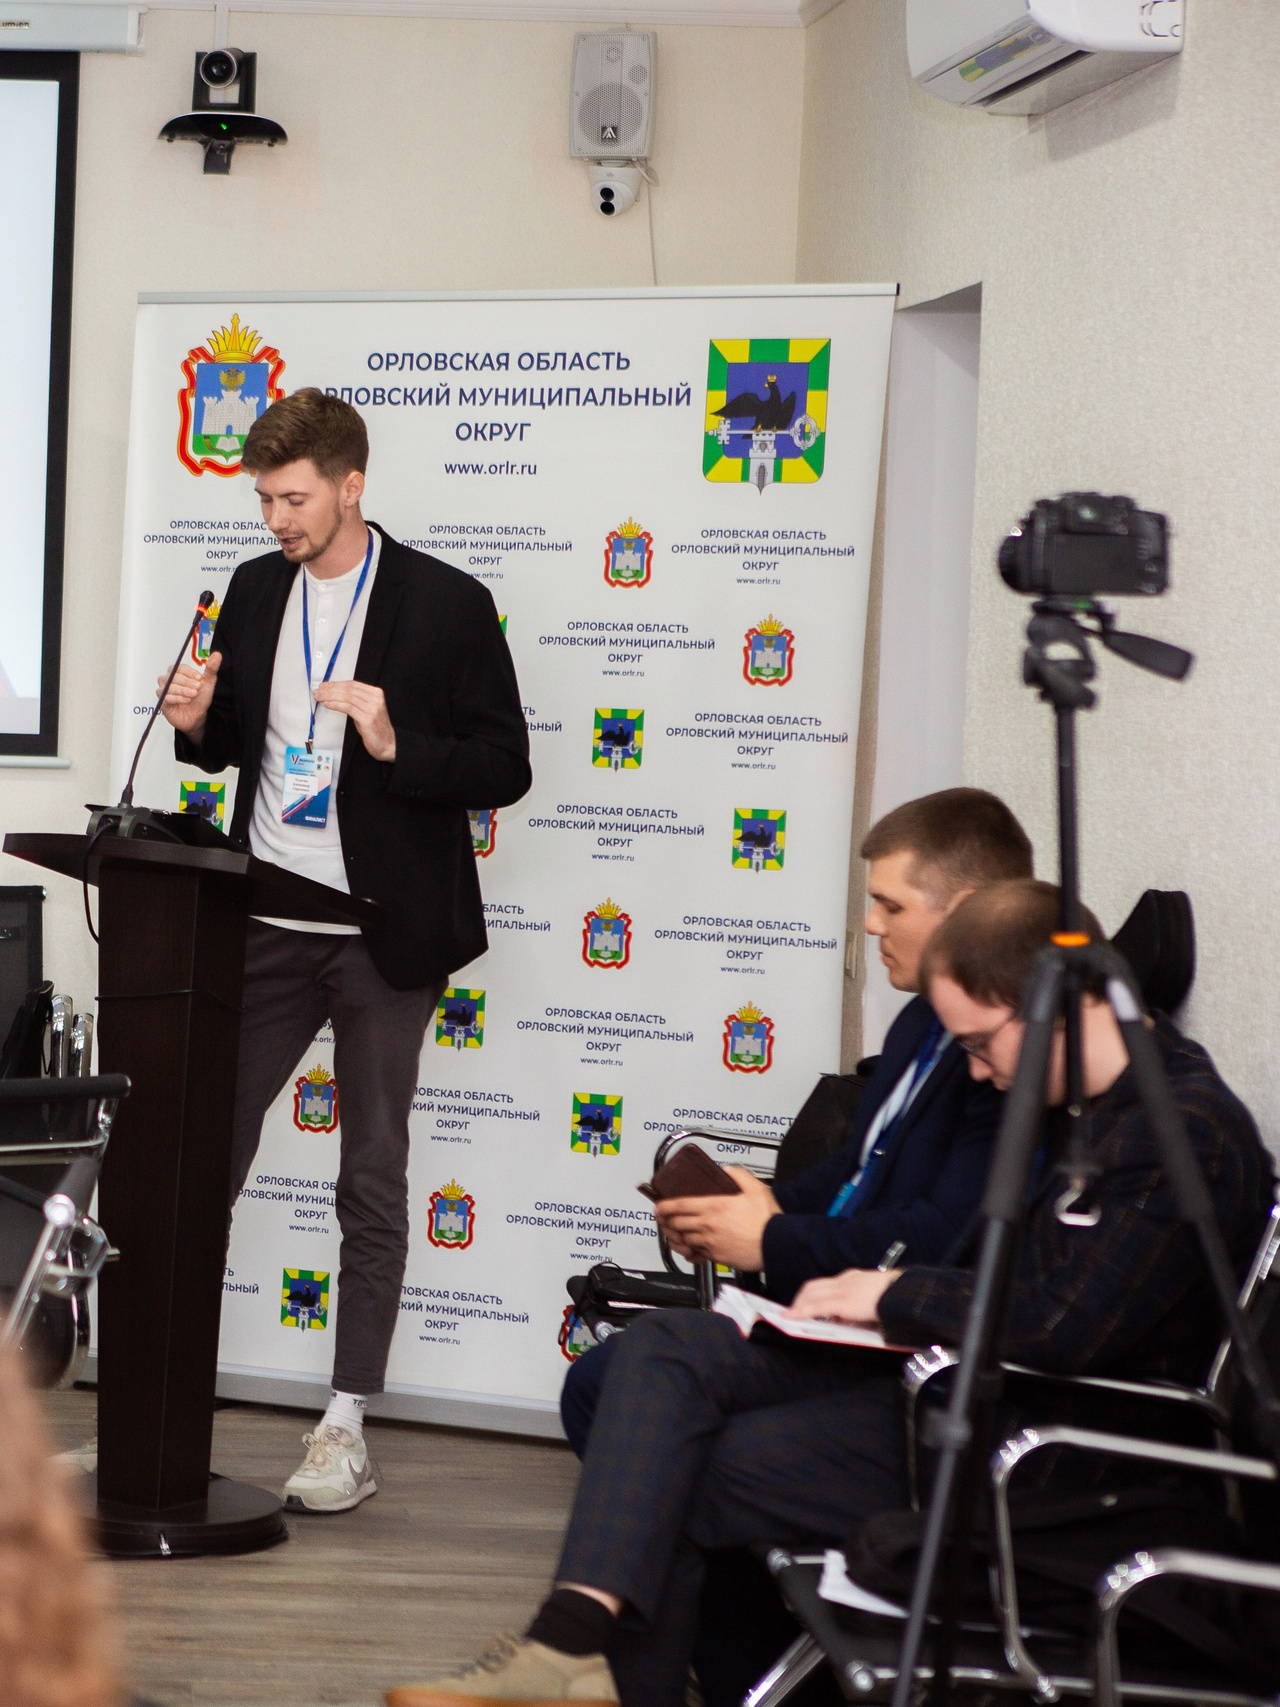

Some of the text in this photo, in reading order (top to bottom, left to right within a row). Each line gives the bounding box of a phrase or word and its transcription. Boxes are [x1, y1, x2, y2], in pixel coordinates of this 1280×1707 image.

[367, 352, 630, 371] ОРЛОВСКАЯ ОБЛАСТЬ
[325, 382, 692, 410] РЛОВСКИЙ МУНИЦИПАЛЬНЫЙ
[455, 422, 531, 442] ОКРУГ
[444, 460, 537, 475] www.orlr.ru
[170, 520, 267, 531] ОРЛОВСКАЯ ОБЛАС
[429, 525, 546, 536] ОРЛОВСКАЯ ОБЛАСТЬ
[143, 534, 280, 546] ОРЛОВСКИЙ МУНИЦИПАЛЬ
[700, 529, 826, 540] ОРЛОВСКАЯ ОБЛАСТЬ
[402, 538, 573, 551] ОРЛОВСКИЙ МУНИЦИПАЛЬНЫЙ
[671, 543, 855, 557] ОРЛОВСКИЙ МУНИЦИПАЛЬНЫЙ
[206, 550, 238, 559] ОКРУГ
[468, 556, 503, 566] ОКРУГ
[742, 561, 779, 570] ОКРУГ
[736, 577, 781, 585] www.orlr.ru
[567, 622, 688, 633] ОРЛОВСКАЯ ОБЛАСТЬ
[539, 635, 715, 649] ОРЛОВСКИЙ МУНИЦИПАЛЬНЫЙ
[608, 653, 643, 663] ОКРУГ
[602, 669, 645, 677] www.orlr.ru
[694, 713, 822, 727] ОРЛОВСКАЯ ОБЛАСТЬ
[666, 727, 849, 743] ОРЛОВСКИЙ МУНИЦИПАЛЬНЫЙ
[737, 746, 774, 755] ОКРУГ
[731, 762, 776, 770] www.orlr.ru
[556, 804, 678, 819] ОРЛОВСКАЯ ОБЛАСТЬ
[528, 818, 705, 836] ОРЛОВСКИЙ МУНИЦИПАЛЬНЫЙ
[597, 837, 633, 847] ОКРУГ
[591, 853, 635, 862] www.orlr.ru
[482, 903, 524, 914] БЛАСТЬ
[486, 919, 550, 931] ИПАЛЬНЫЙ
[683, 915, 811, 932] ОРЛОВСКАЯ ОБЛАСТЬ
[654, 930, 837, 949] ОРЛОВСКИЙ МУНИЦИПАЛЬНЫЙ
[726, 950, 764, 960] ОКРУГ
[720, 966, 765, 975] www.orlr.ru
[545, 1007, 666, 1024] ОРЛОВСКАЯ ОБЛАСТЬ
[517, 1021, 694, 1042] ОРЛОВСКИЙ МУНИЦИПАЛЬНЫЙ
[586, 1041, 622, 1052] ОКРУГ
[580, 1057, 623, 1066] www.orlr.ru
[415, 1086, 514, 1103] ОВСКАЯ ОБЛАСТЬ
[437, 1103, 540, 1121] МУНИЦИПАЛЬНЫЙ
[673, 1108, 794, 1127] ОРЛОВСКАЯ ОБЛАСТ
[436, 1119, 470, 1130] ОКРУГ
[430, 1135, 471, 1144] www.orlr.ru
[716, 1143, 753, 1154] ОКРУГ
[256, 1175, 318, 1189] ОРЛОВСКАЯ
[239, 1188, 293, 1202] РЛОВСКИЙ
[294, 1209, 328, 1220] ОКРУГ
[534, 1201, 656, 1222] ОРЛОВСКАЯ ОБЛАСТЬ
[289, 1224, 329, 1234] www.orlr.ru
[506, 1214, 658, 1237] ОРЛОВСКИЙ МУНИЦИПАЛЬ
[576, 1236, 611, 1248] ОКРУГ
[570, 1252, 613, 1262] www.orlr.ru
[402, 1285, 503, 1305] ЛОВСКАЯ ОБЛАСТЬ
[426, 1304, 529, 1323] МУНИЦИПАЛЬНЫЙ
[424, 1319, 459, 1331] ОКРУГ
[419, 1335, 460, 1345] www.orlr.ru
